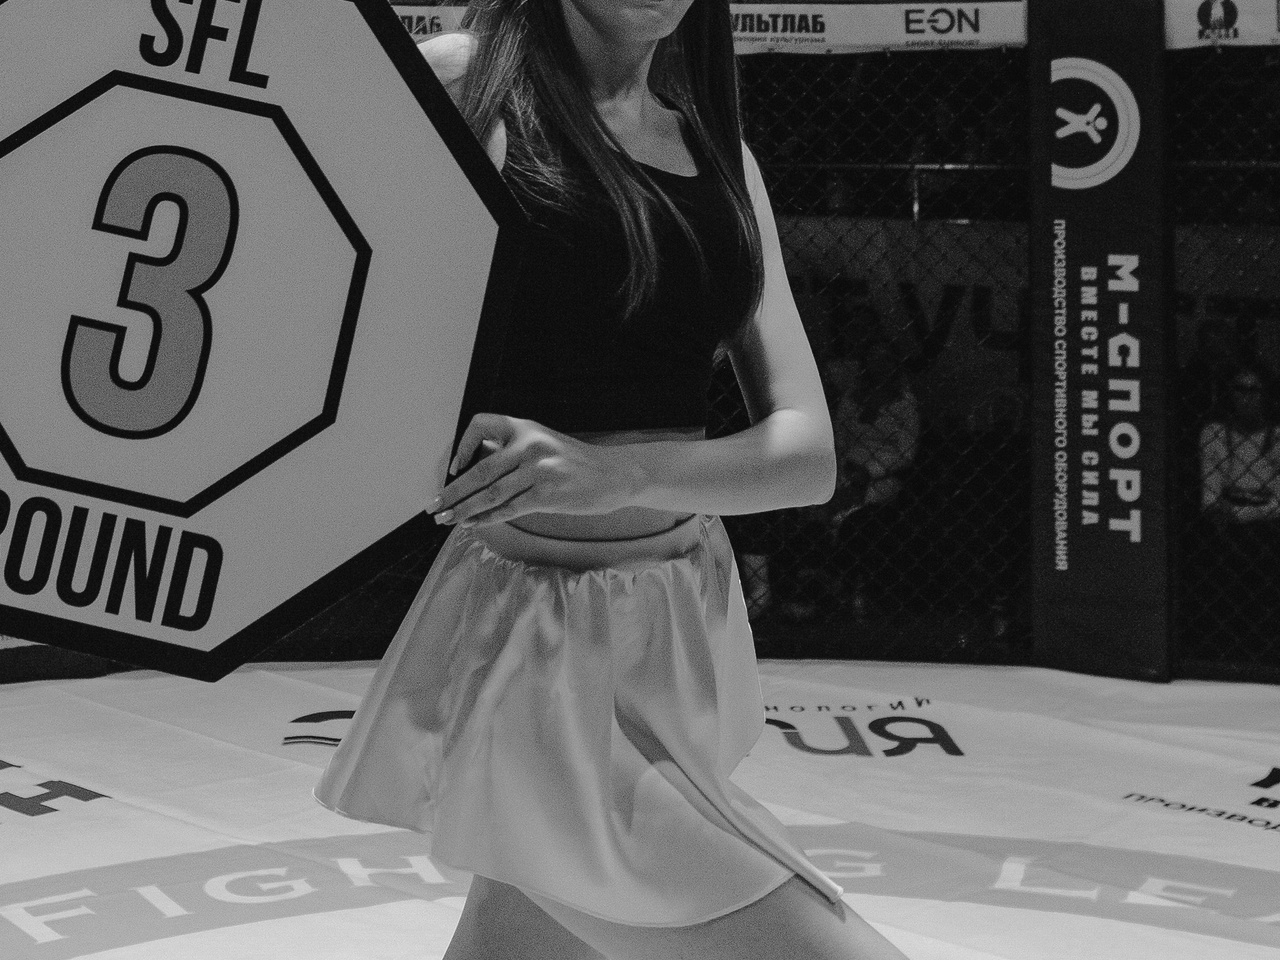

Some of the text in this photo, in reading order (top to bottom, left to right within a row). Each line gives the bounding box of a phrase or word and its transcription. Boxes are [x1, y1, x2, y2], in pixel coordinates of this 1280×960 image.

[731, 13, 826, 34] УЛЬТЛАБ
[61, 144, 240, 440] 3
[1051, 219, 1070, 571] ПРОИЗВОДСТВО СПОРТИВНОГО ОБОРУДОВАНИЯ
[1081, 266, 1099, 525] ВМЕСТЕ МЫ СИЛА
[1107, 253, 1142, 542] М-СПОРТ
